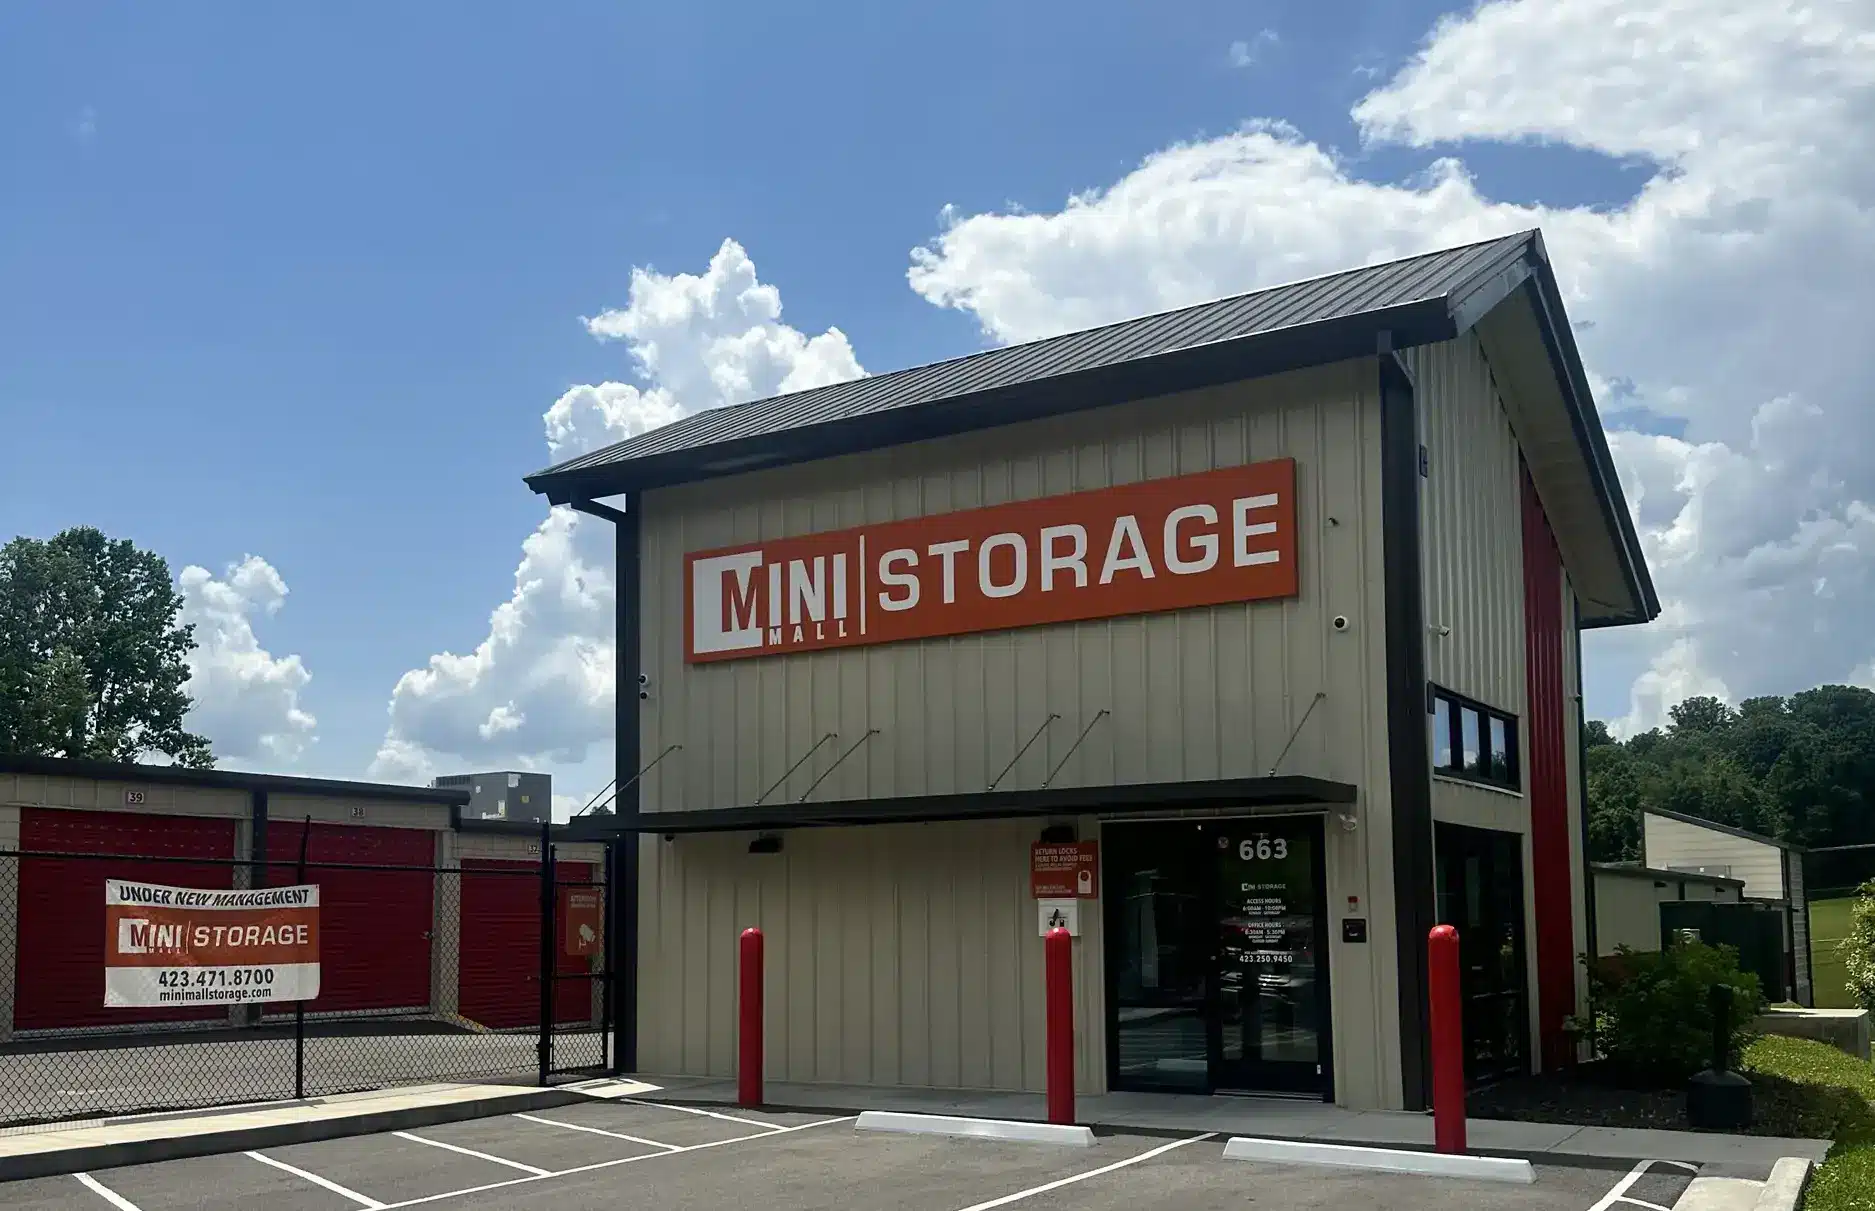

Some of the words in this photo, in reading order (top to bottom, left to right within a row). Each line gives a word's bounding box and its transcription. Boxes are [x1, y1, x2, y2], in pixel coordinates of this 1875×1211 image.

[720, 552, 847, 632] MINI
[878, 492, 1281, 612] STORAGE
[769, 620, 847, 646] MALL
[130, 792, 142, 802] 39
[353, 807, 364, 817] 38
[1239, 838, 1288, 860] 663
[119, 885, 171, 905] UNDER
[175, 890, 211, 906] NEW
[212, 889, 310, 907] MANAGEMENT
[130, 922, 182, 949] MINI
[193, 924, 308, 947] STORAGE
[1239, 955, 1293, 963] 423.250.9450
[158, 968, 274, 987] 423.471.8700
[159, 986, 272, 1002] minimallstorage.com
